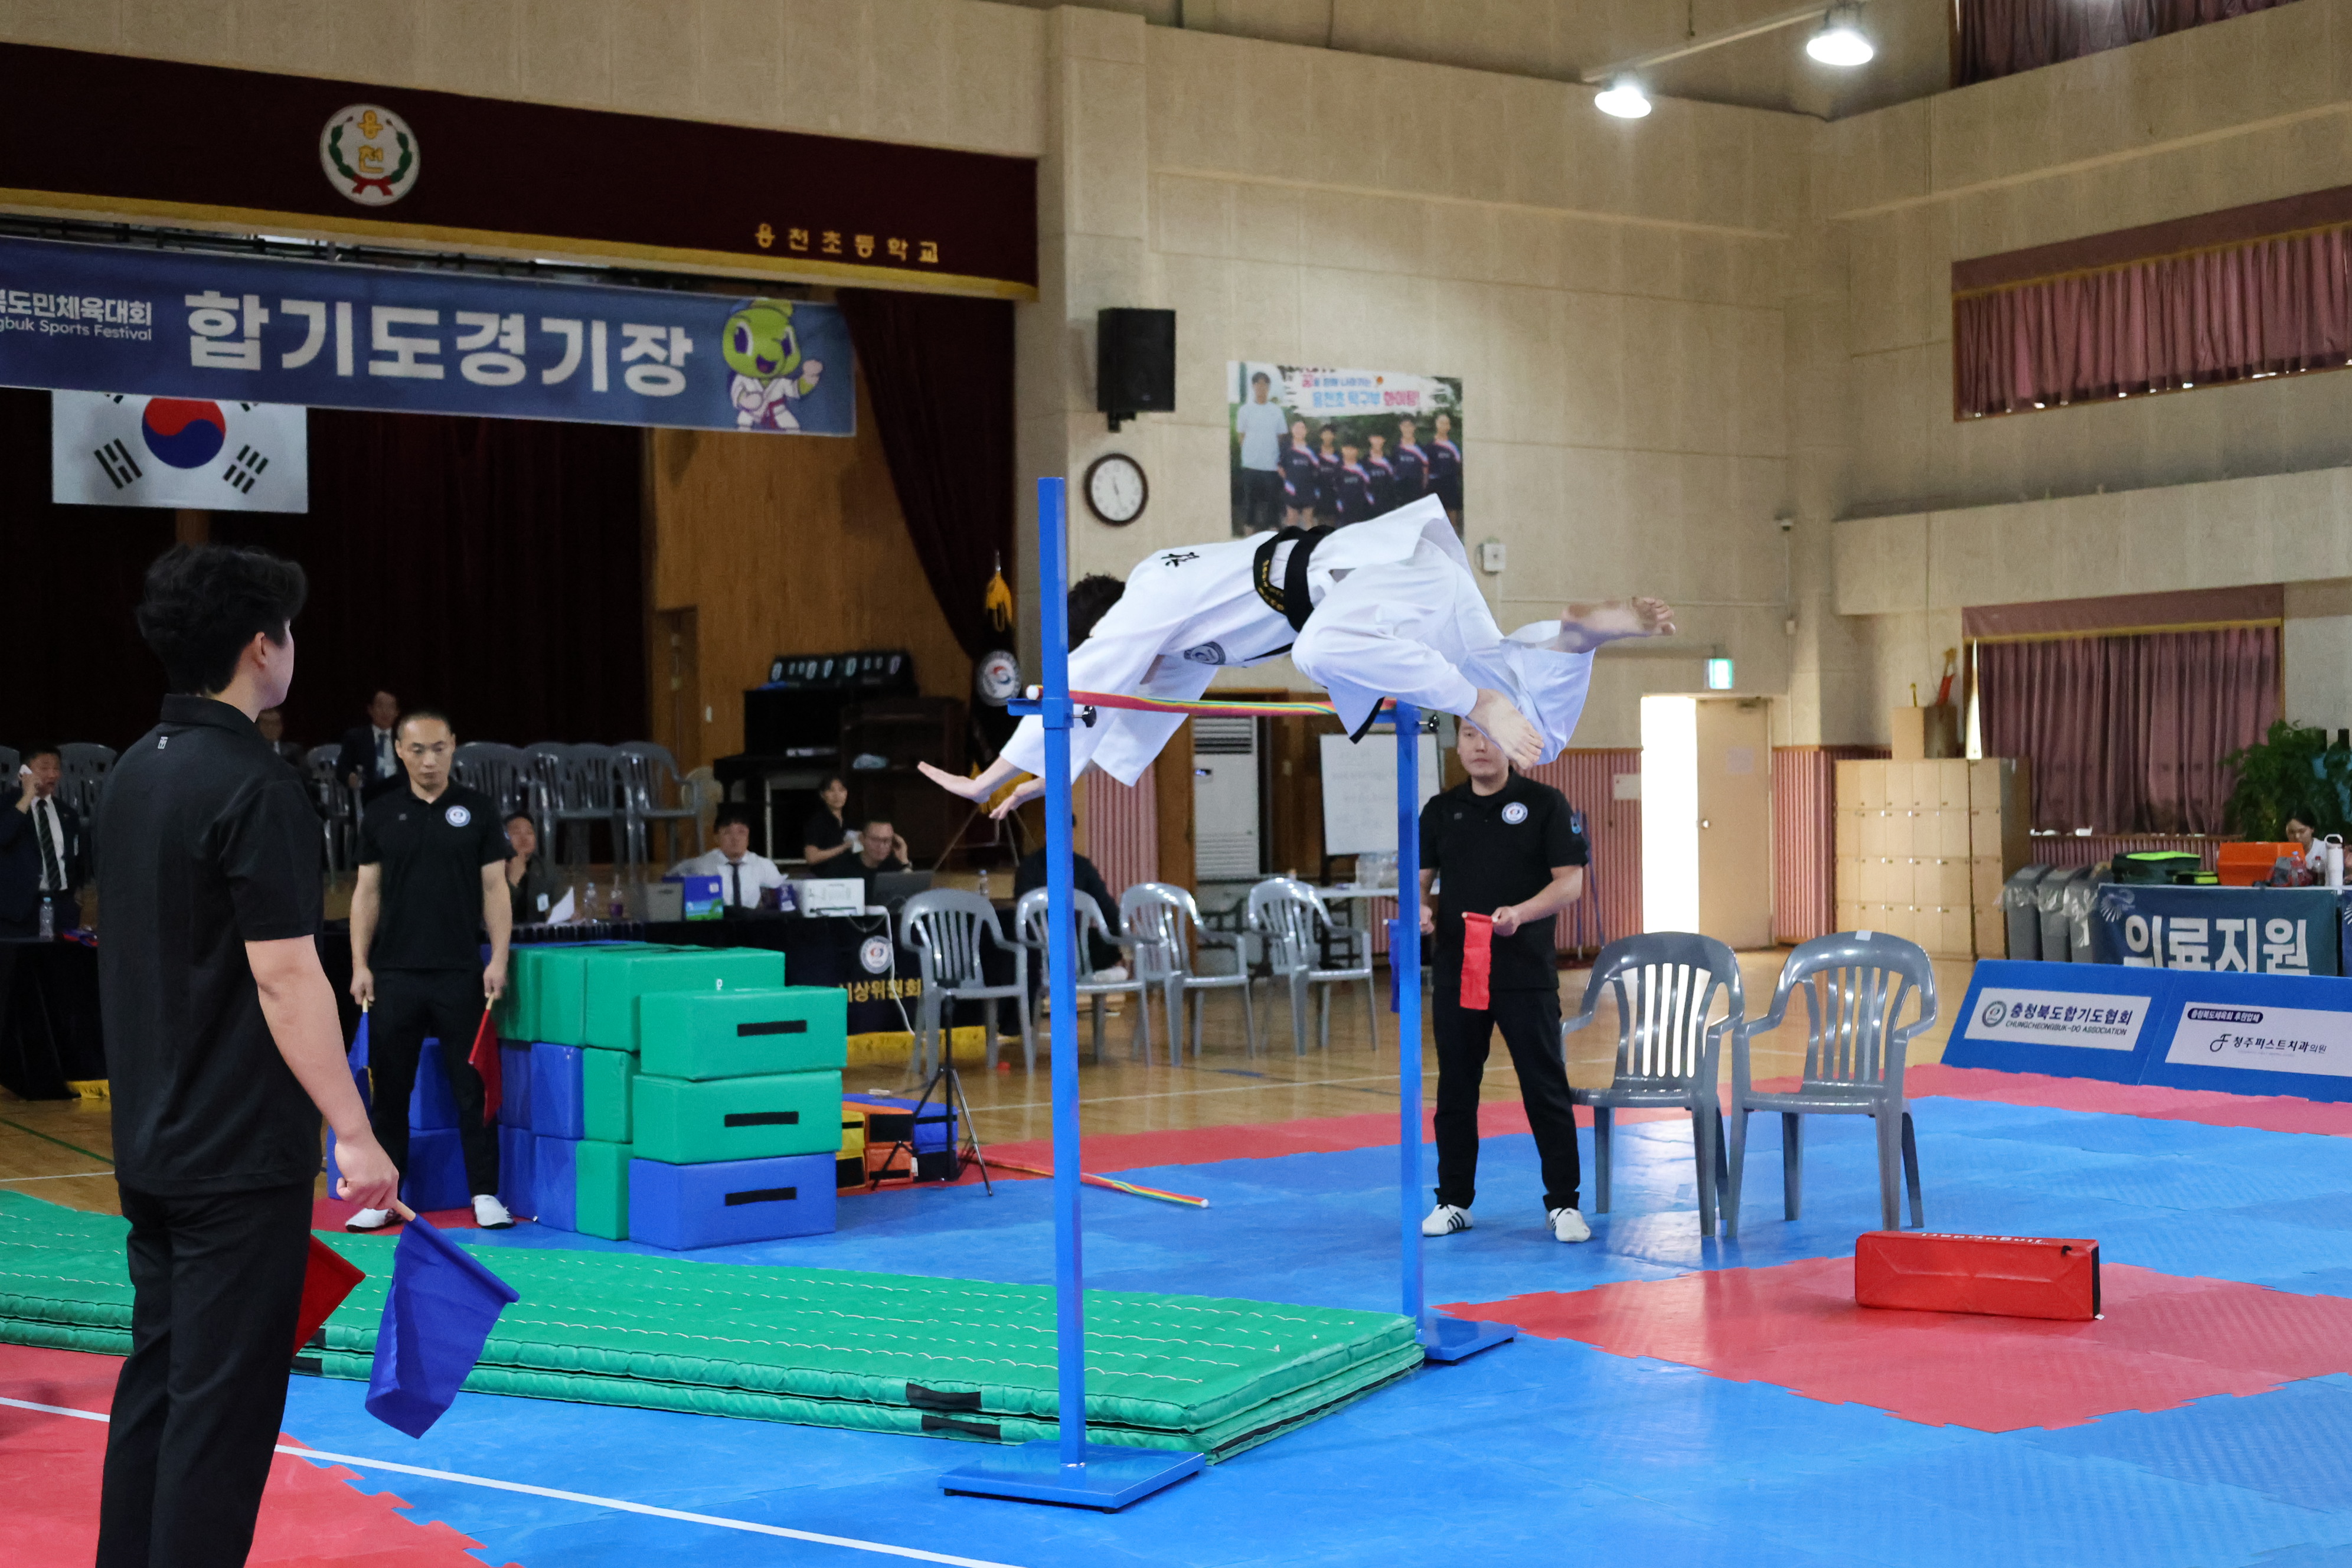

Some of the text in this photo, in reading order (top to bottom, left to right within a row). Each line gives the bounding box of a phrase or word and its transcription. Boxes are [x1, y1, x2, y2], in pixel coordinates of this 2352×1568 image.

[40, 319, 89, 336] Sports
[94, 324, 152, 341] Festival
[2123, 914, 2309, 975] 의료지원
[2010, 1002, 2133, 1025] 충청북도합기도협회
[2082, 1025, 2127, 1035] ASSOCIATION
